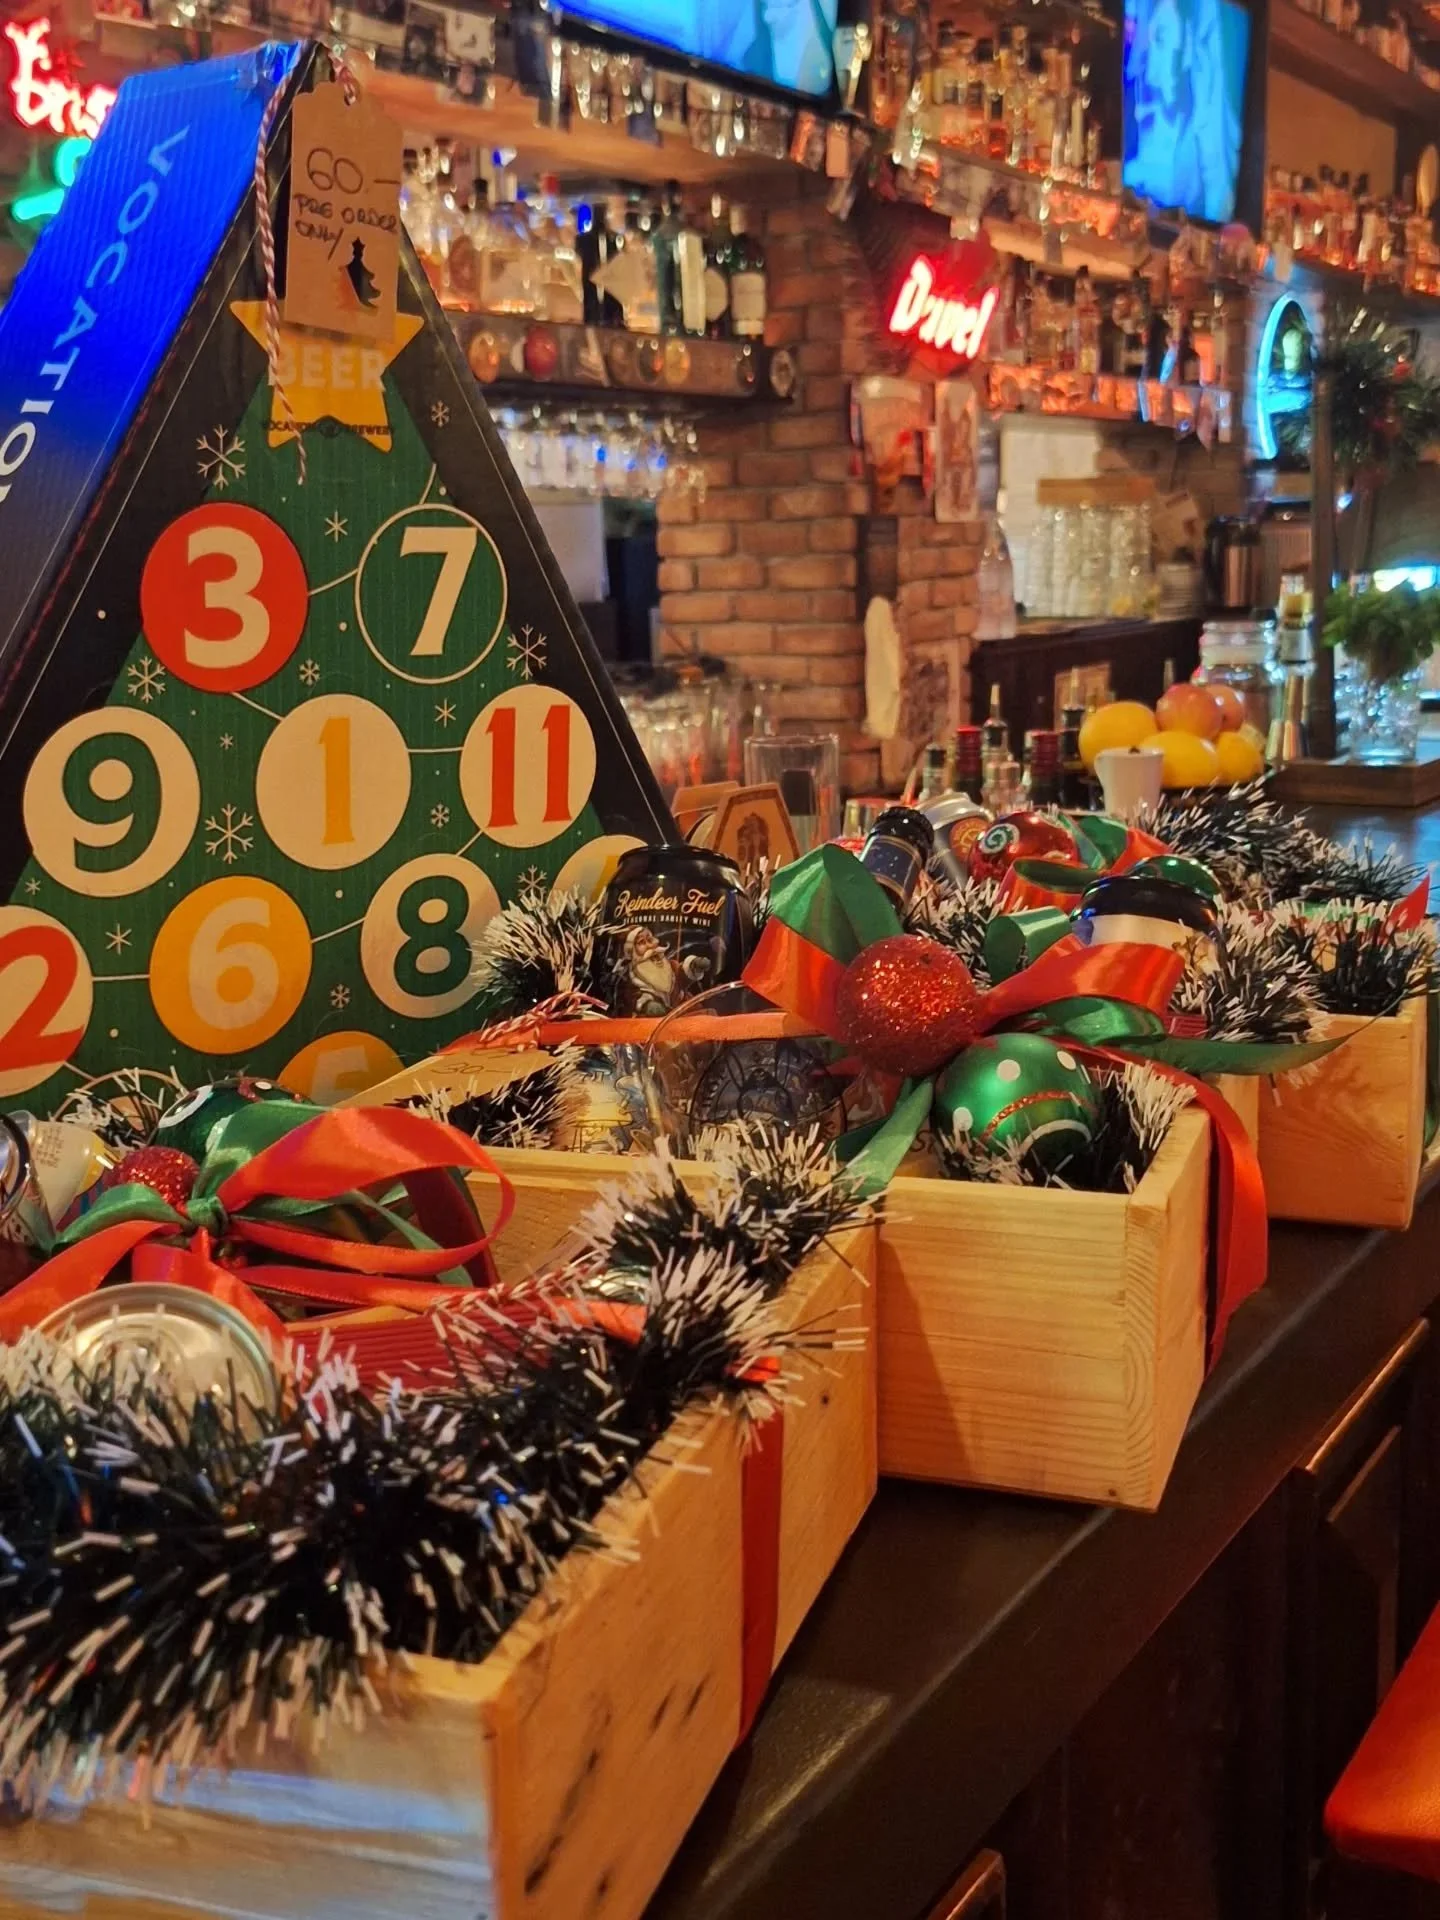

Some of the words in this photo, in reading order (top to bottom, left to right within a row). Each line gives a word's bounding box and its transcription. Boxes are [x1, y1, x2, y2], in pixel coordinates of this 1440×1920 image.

[0, 125, 190, 503] VOCATIO
[268, 341, 387, 393] BEER
[184, 526, 270, 668] 3
[400, 526, 477, 656] 7
[62, 732, 162, 873] 9
[319, 716, 355, 845] 1
[485, 704, 573, 829] 11
[188, 897, 279, 1030] 6
[393, 874, 473, 998] 8
[614, 887, 680, 918] Reindeer
[680, 888, 726, 916] Fuel
